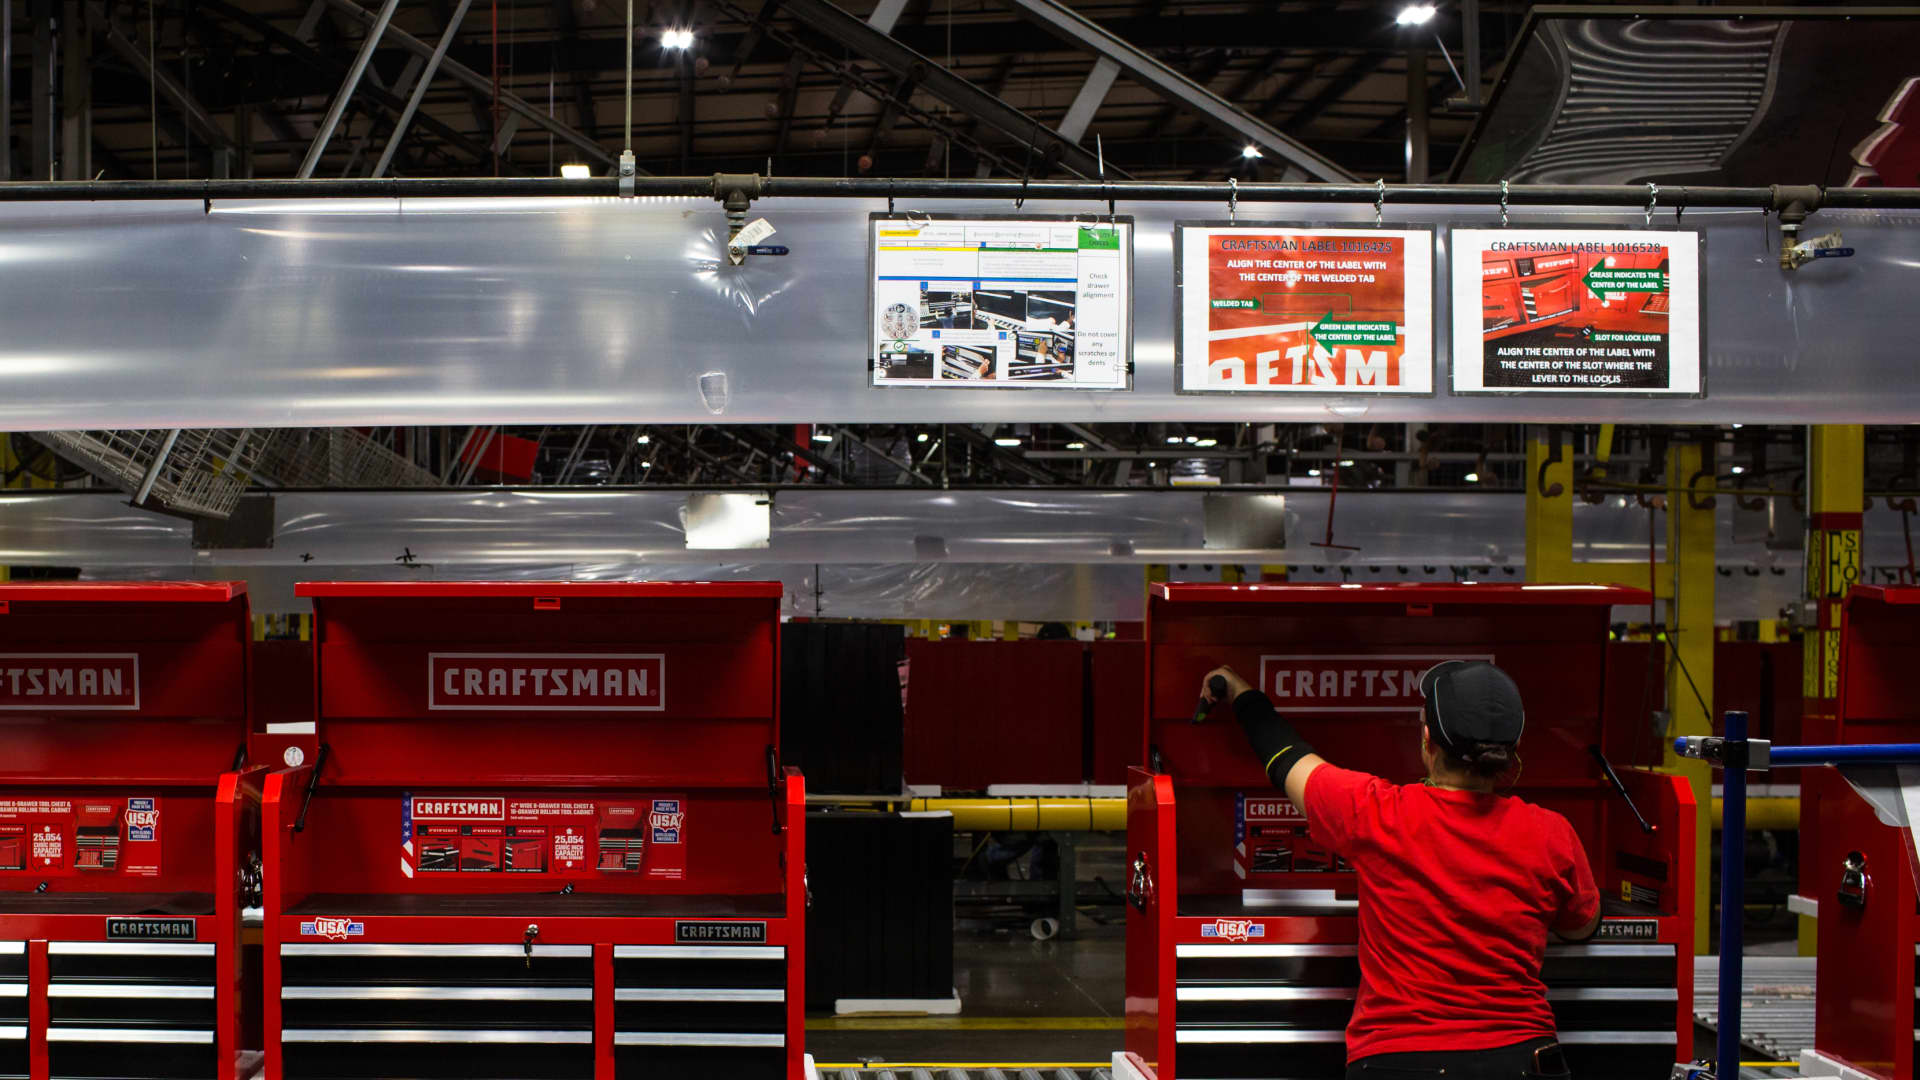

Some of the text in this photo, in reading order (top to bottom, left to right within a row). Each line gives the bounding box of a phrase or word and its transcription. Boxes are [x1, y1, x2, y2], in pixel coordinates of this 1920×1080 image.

[1221, 240, 1392, 253] CRAFTSMAN LABEL 1016425
[1491, 241, 1661, 253] CRAFTSMAN LABEL 1016528
[1227, 260, 1387, 270] ALIGN THE CENTER OF THE LABEL WITH
[1239, 273, 1256, 281] THE
[1257, 273, 1289, 282] CENTER
[1304, 274, 1319, 282] THE
[1321, 274, 1357, 283] WELDED
[1358, 274, 1375, 283] TAB
[1497, 348, 1656, 357] ALIGN THE CENTER OF THE LABEL WITH
[1209, 344, 1404, 385] AFTSM
[1501, 361, 1517, 369] THE
[1518, 361, 1550, 369] CENTER
[1552, 361, 1564, 369] OF
[1565, 361, 1581, 369] THE
[1604, 362, 1634, 370] WHERE
[1636, 362, 1653, 370] THE
[1532, 375, 1621, 383] LEVER TO THE LOCK IS
[1828, 531, 1843, 598] E
[0, 668, 122, 695] TSMAN
[444, 668, 648, 696] CRAFTSMAN
[417, 802, 498, 815] CRAFTSMAN
[128, 812, 154, 825] USA
[653, 815, 679, 827] USA
[33, 833, 61, 842] 25,054
[555, 835, 584, 844] 25,054
[112, 923, 190, 935] CRAFTSMAN
[318, 921, 346, 934] USA
[681, 926, 760, 938] CRAFTSMAN
[1219, 923, 1246, 936] USA
